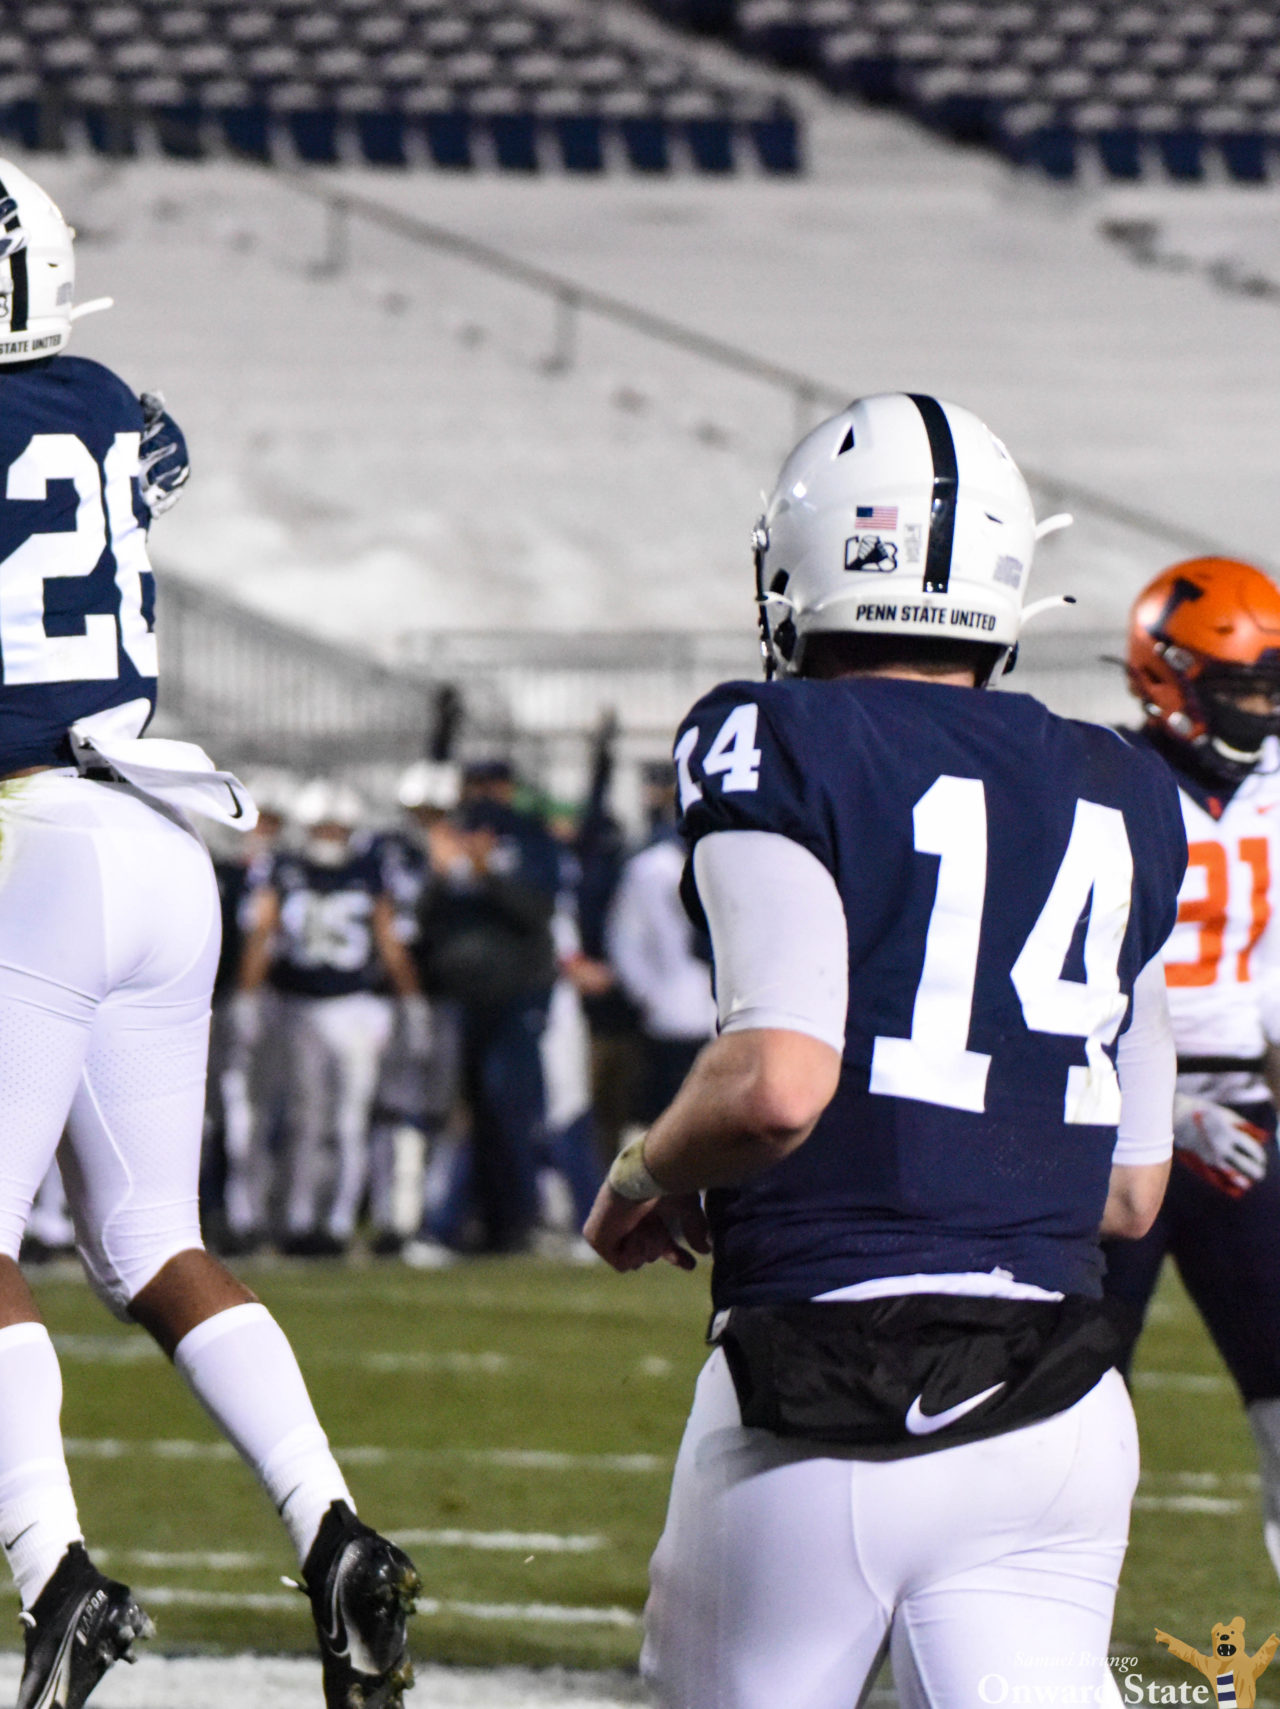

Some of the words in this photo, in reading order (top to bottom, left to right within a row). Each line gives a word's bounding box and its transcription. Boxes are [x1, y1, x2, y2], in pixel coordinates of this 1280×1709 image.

[856, 604, 897, 621] PENN
[901, 605, 947, 624] STATE
[951, 610, 996, 631] UNITED
[674, 703, 761, 814] 14
[869, 774, 1134, 1127] 14
